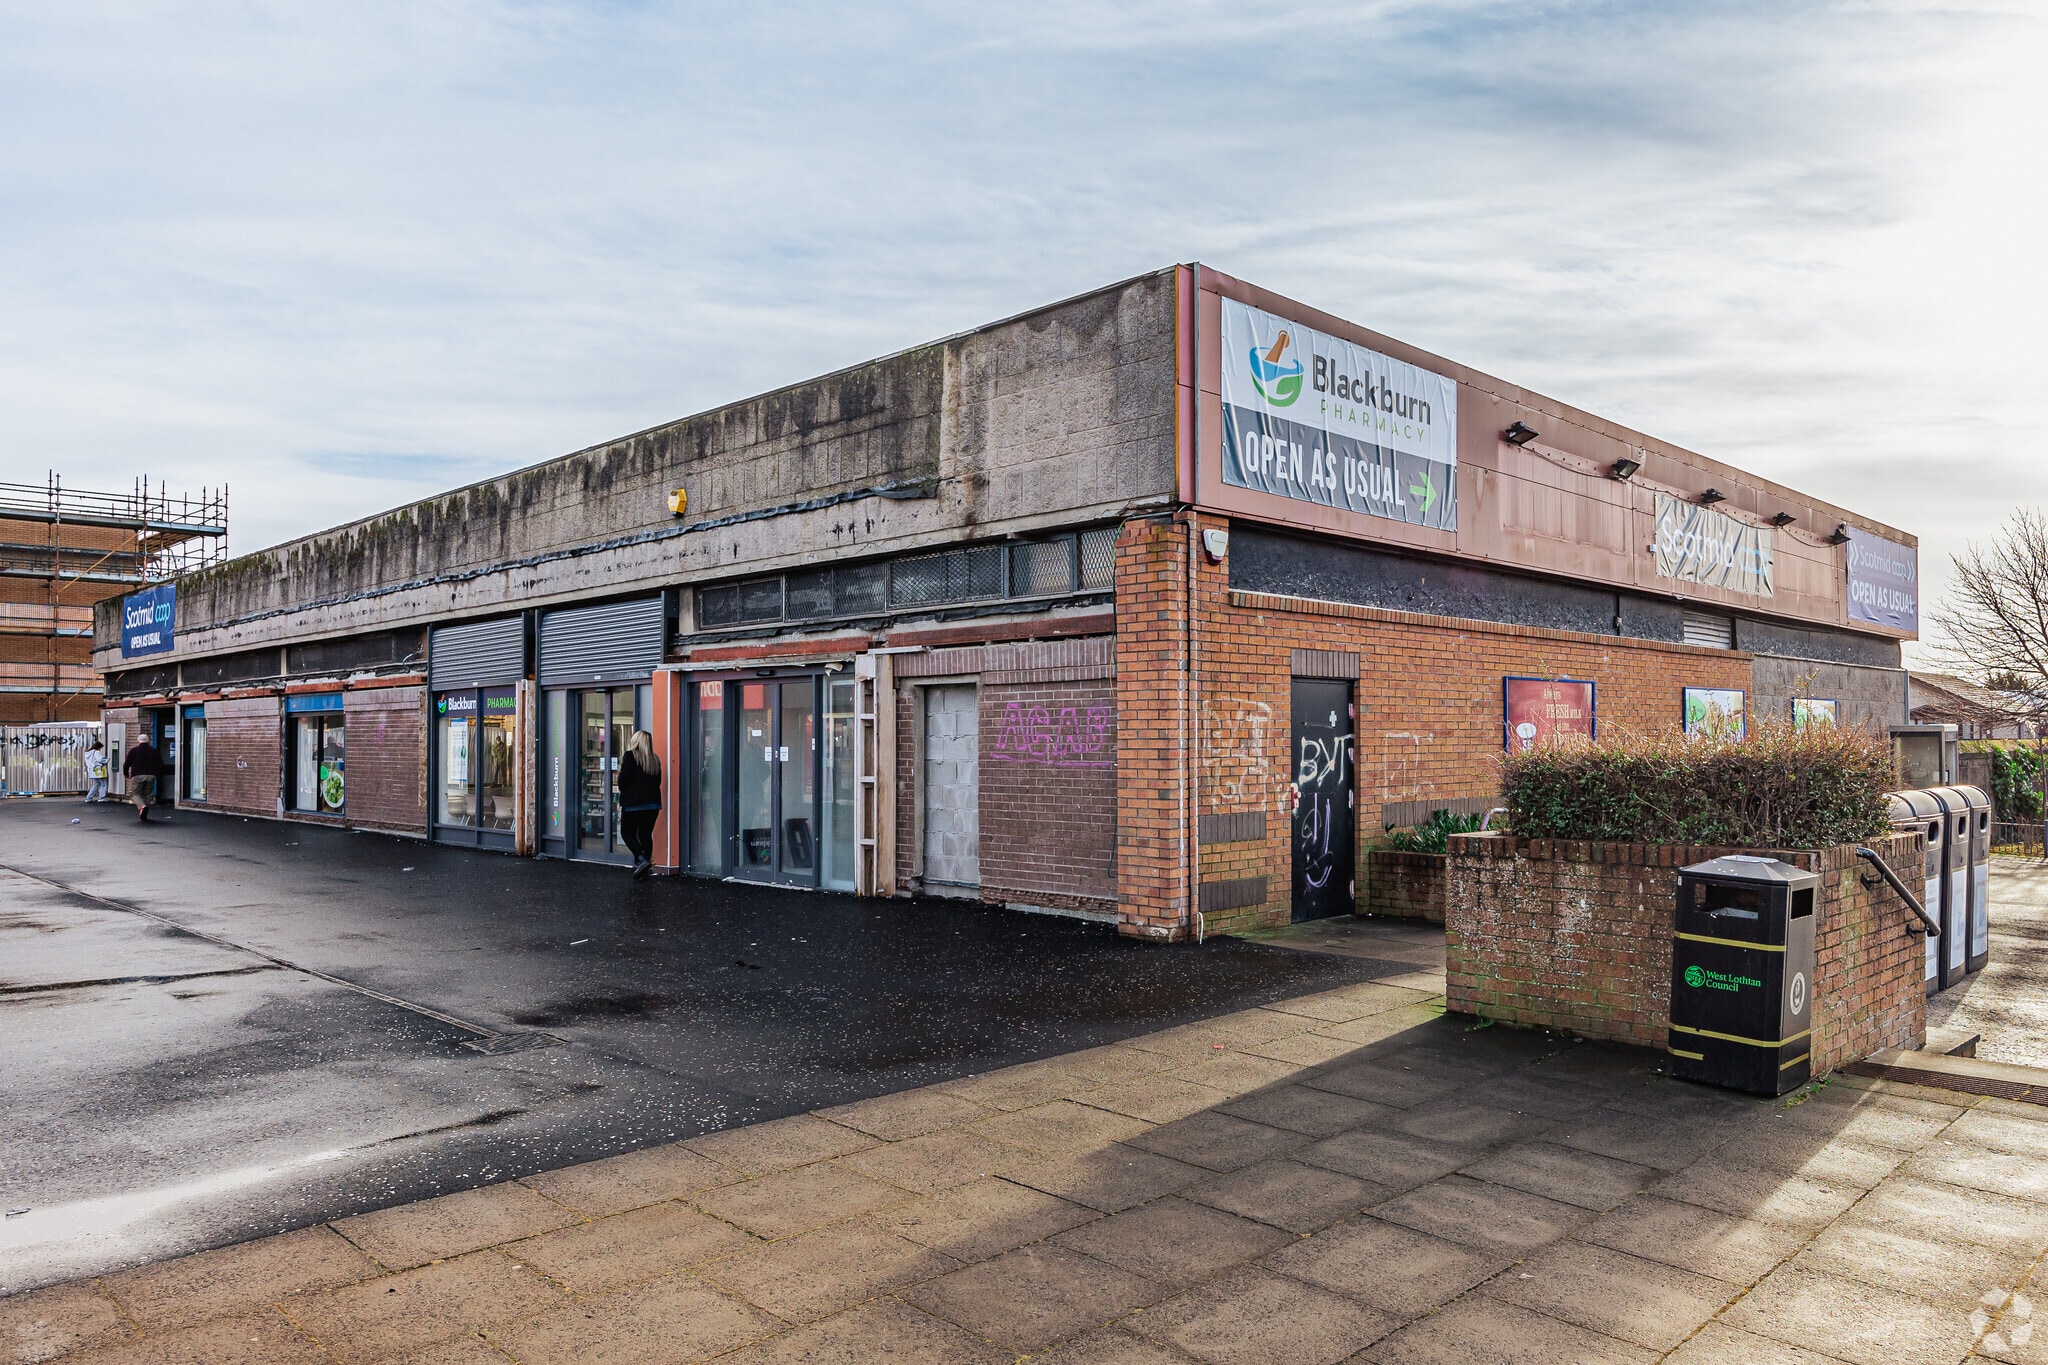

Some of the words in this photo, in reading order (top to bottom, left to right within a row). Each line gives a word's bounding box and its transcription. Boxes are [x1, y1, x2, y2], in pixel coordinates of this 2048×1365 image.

[1312, 354, 1431, 425] Blackburn
[1320, 399, 1426, 442] PHARMACY
[1245, 431, 1303, 483] OPEN
[1311, 448, 1337, 491] AS
[1344, 456, 1405, 506] USUAL
[1661, 515, 1735, 568] Scotmid
[1860, 545, 1891, 573] Scotmid
[1892, 561, 1907, 582] coop
[1851, 579, 1876, 605] OPEN
[1877, 586, 1888, 609] AS
[1889, 589, 1914, 614] USUAL
[126, 600, 155, 629] Scotmid
[155, 602, 171, 627] coop
[131, 635, 143, 649] OPEN
[143, 634, 148, 647] AS
[147, 631, 161, 646] USUAL
[448, 697, 476, 710] Blackburn
[487, 697, 516, 709] PHARMAC
[1546, 703, 1569, 719] FRESH
[1570, 708, 1582, 719] MILK
[1705, 979, 1739, 992] Council
[1706, 970, 1727, 982] West
[1728, 974, 1762, 987] Lothian
